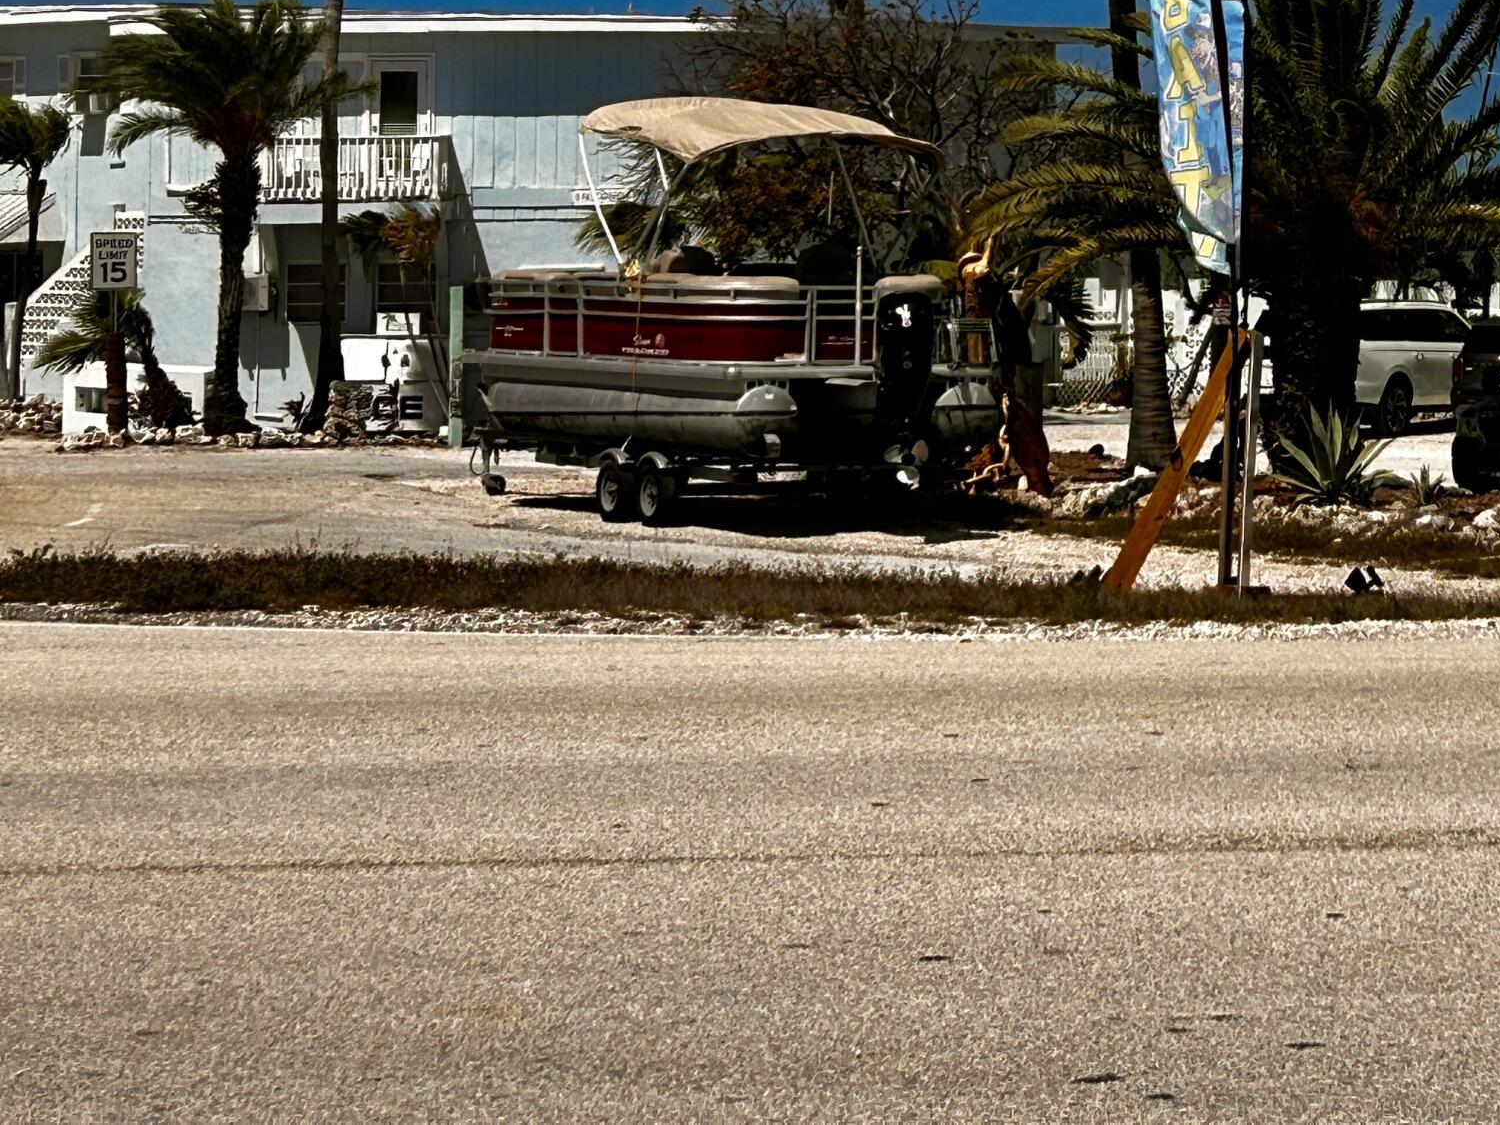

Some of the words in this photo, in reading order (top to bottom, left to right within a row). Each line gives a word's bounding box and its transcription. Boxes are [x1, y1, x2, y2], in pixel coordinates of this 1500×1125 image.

[95, 238, 134, 249] SPEED
[98, 250, 128, 260] LIMIT
[100, 261, 127, 283] 15
